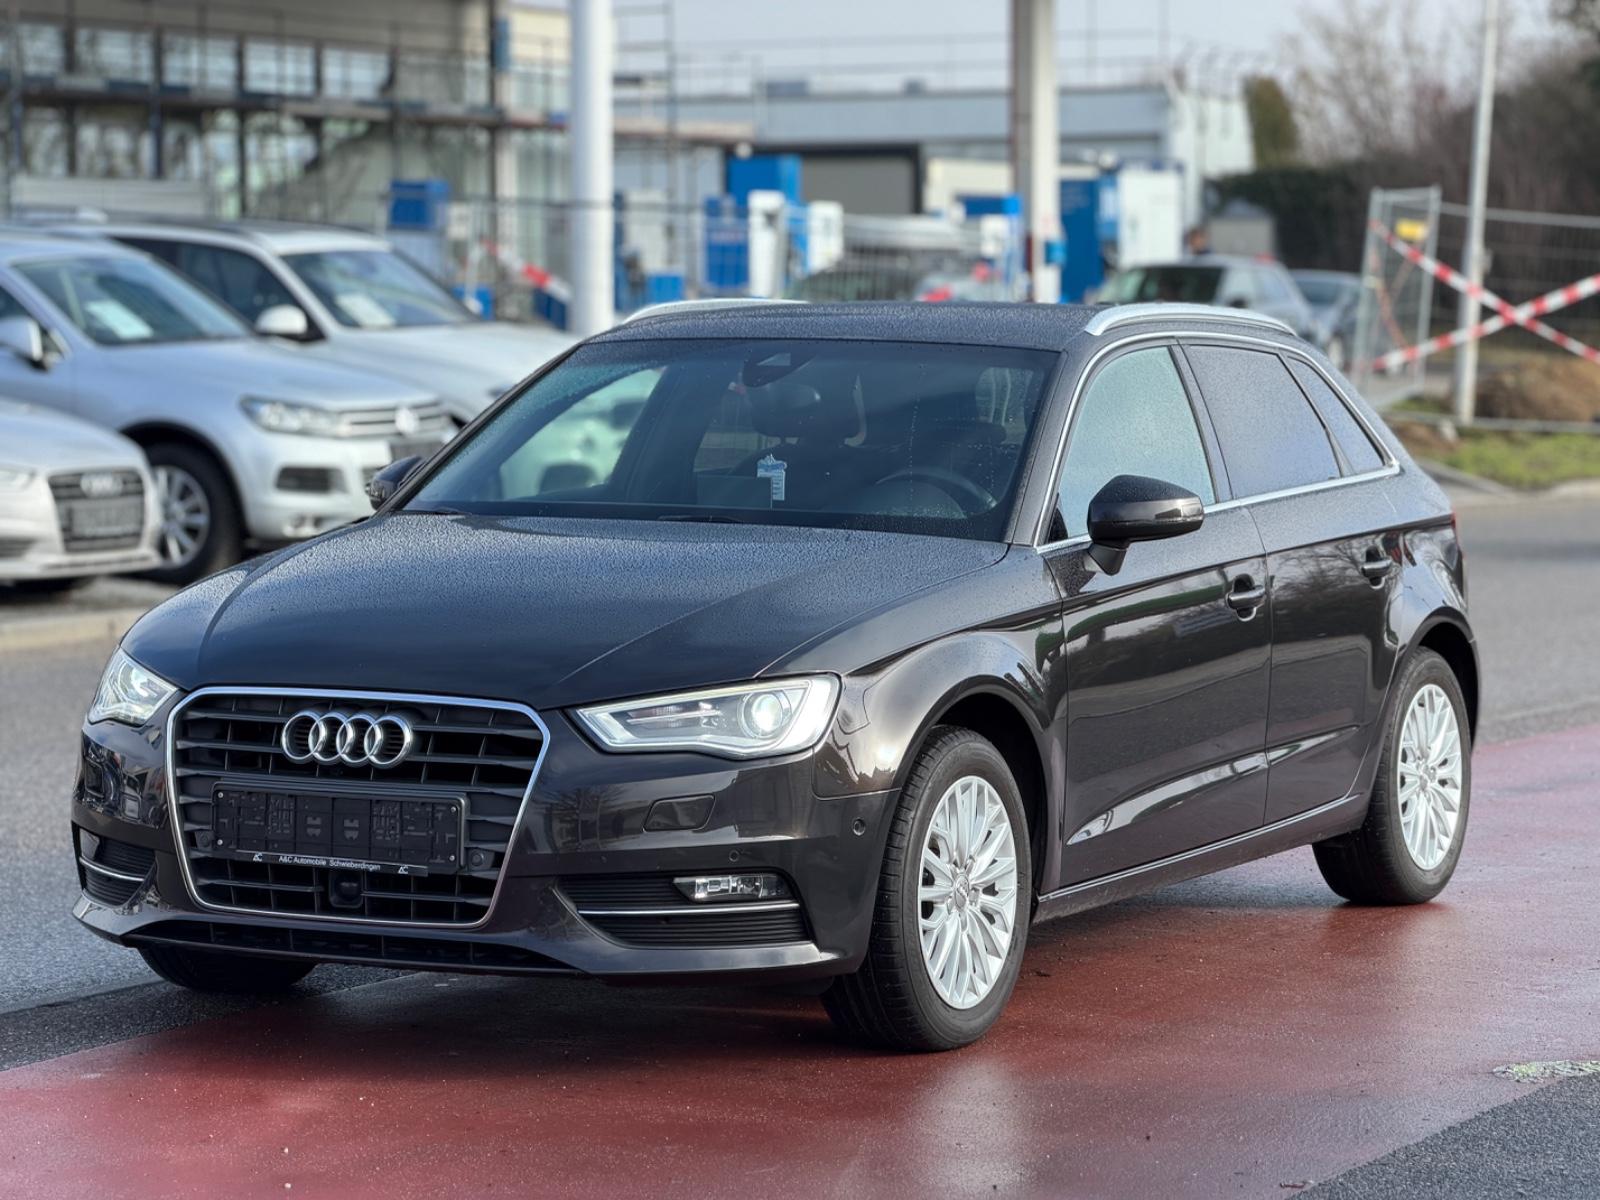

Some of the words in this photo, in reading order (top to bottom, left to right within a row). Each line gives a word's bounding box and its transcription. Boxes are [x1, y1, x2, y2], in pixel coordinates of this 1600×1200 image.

[279, 855, 293, 864] A&C
[293, 857, 327, 866] Automobile
[329, 859, 381, 872] Schwieberdingen
